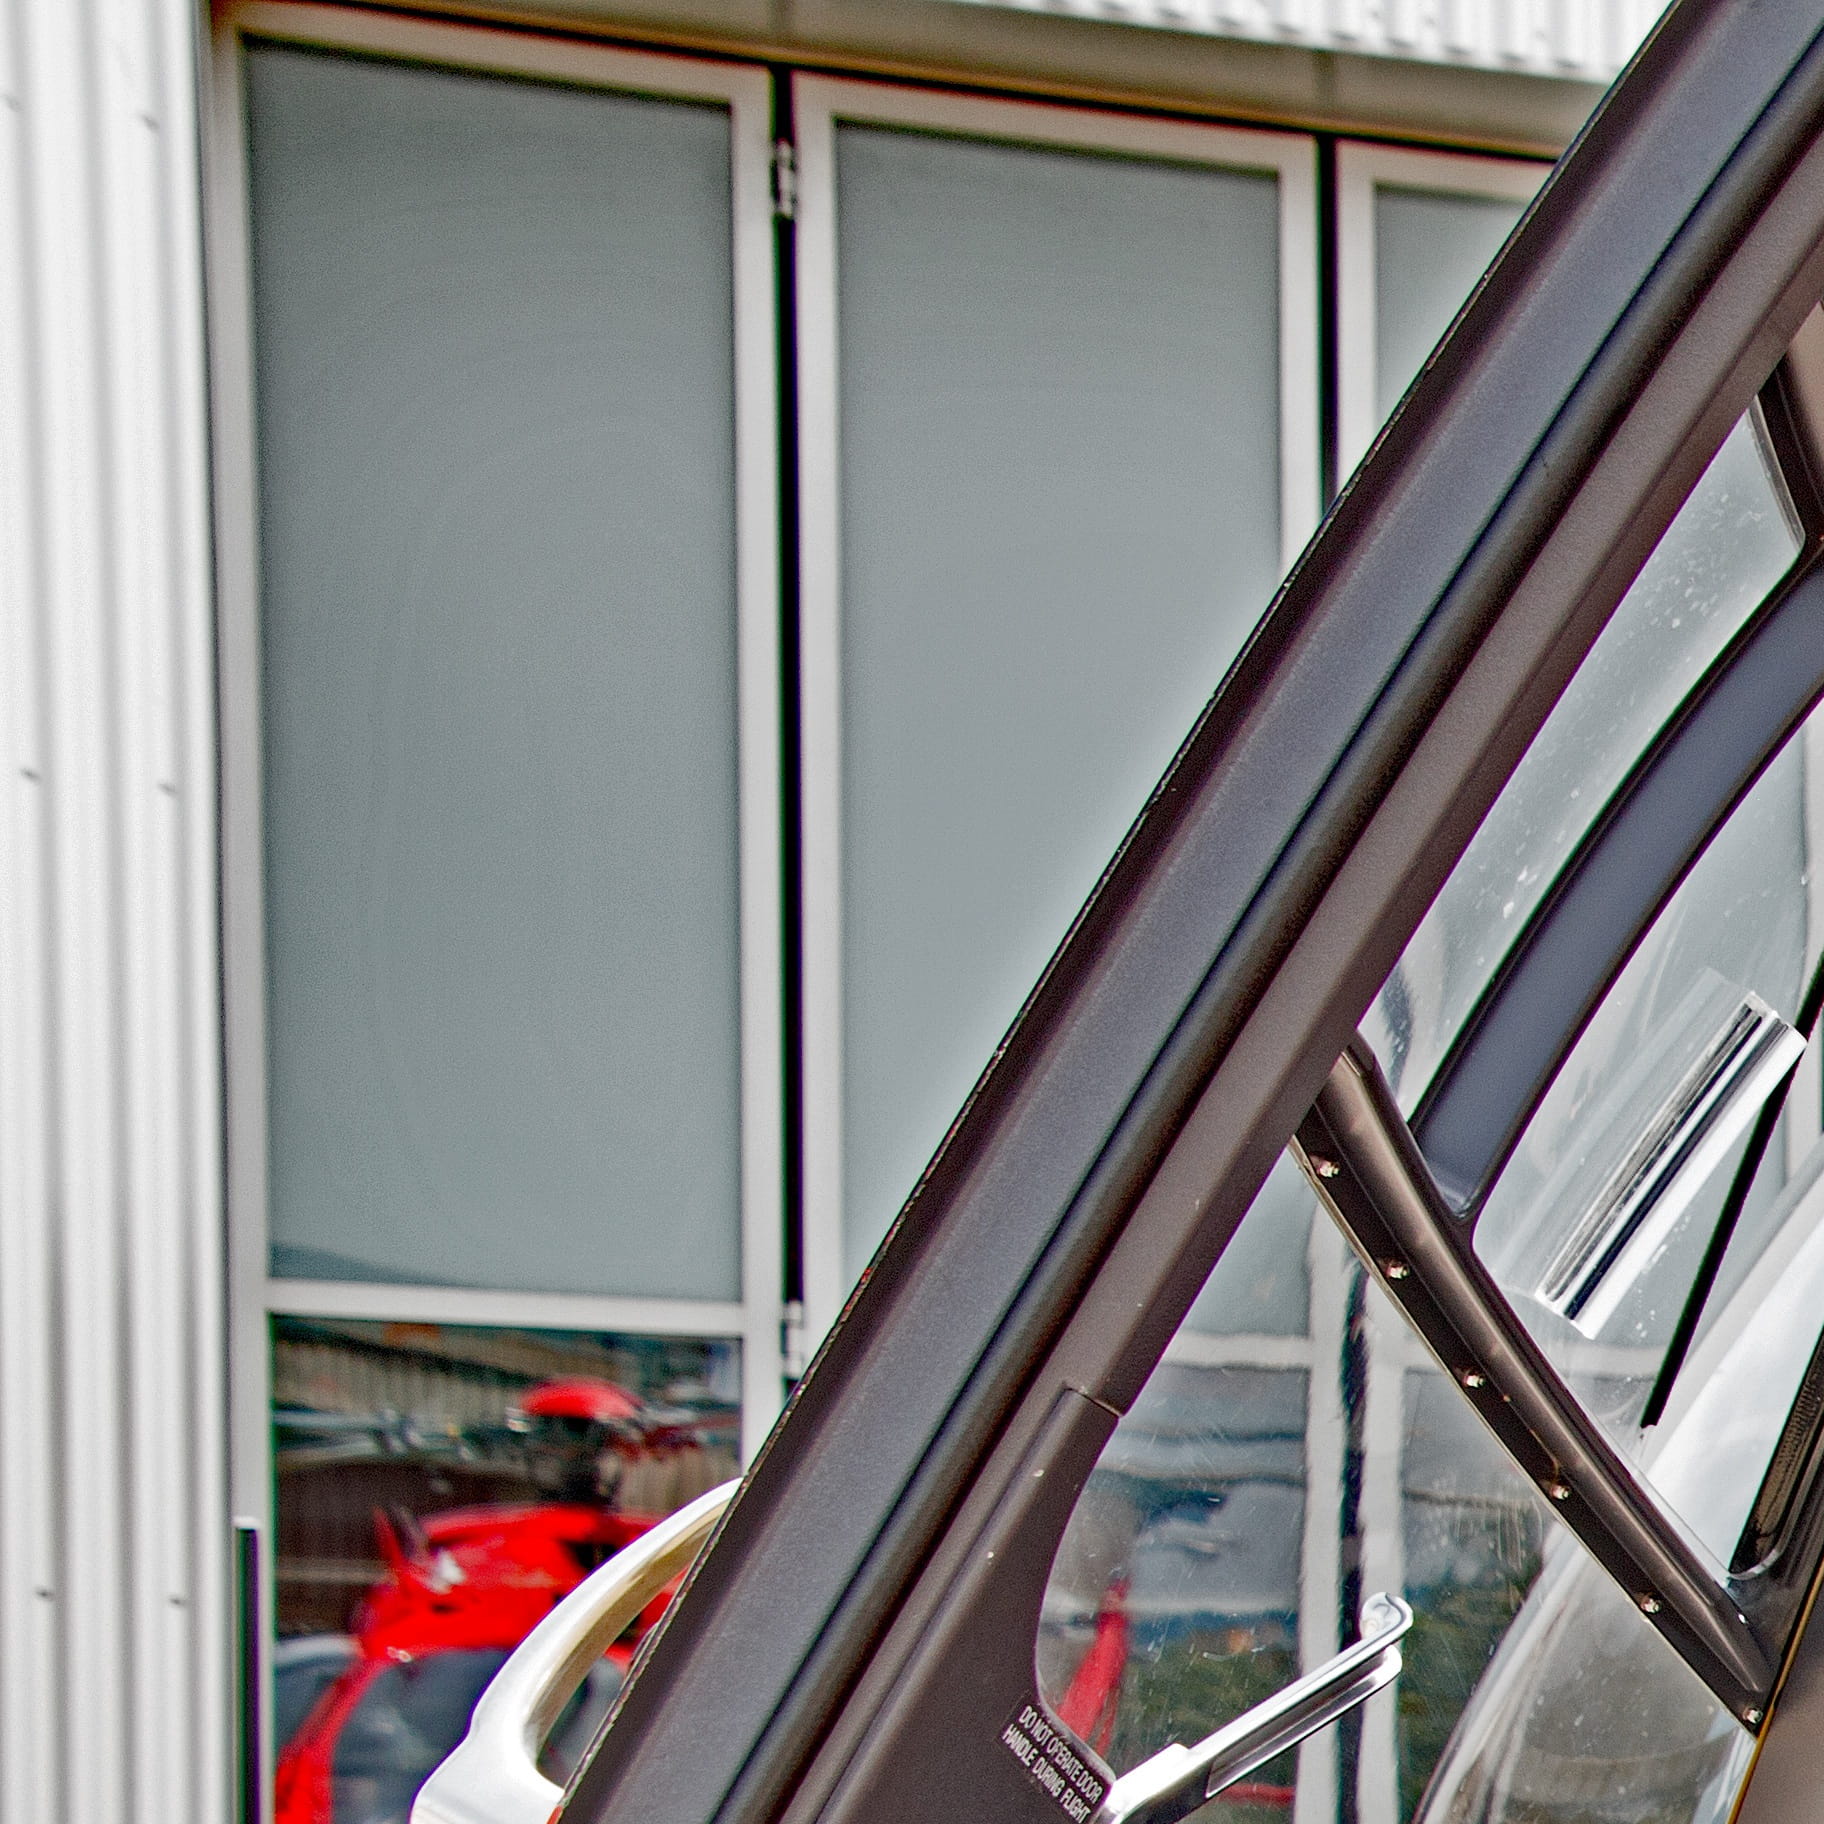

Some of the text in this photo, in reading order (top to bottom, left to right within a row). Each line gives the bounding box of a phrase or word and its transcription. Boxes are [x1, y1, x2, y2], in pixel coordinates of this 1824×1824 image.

[1002, 1723, 1092, 1824] HANDLE DURING FLIGHT
[1019, 1705, 1104, 1805] DO NOT OPERATE DOOR
